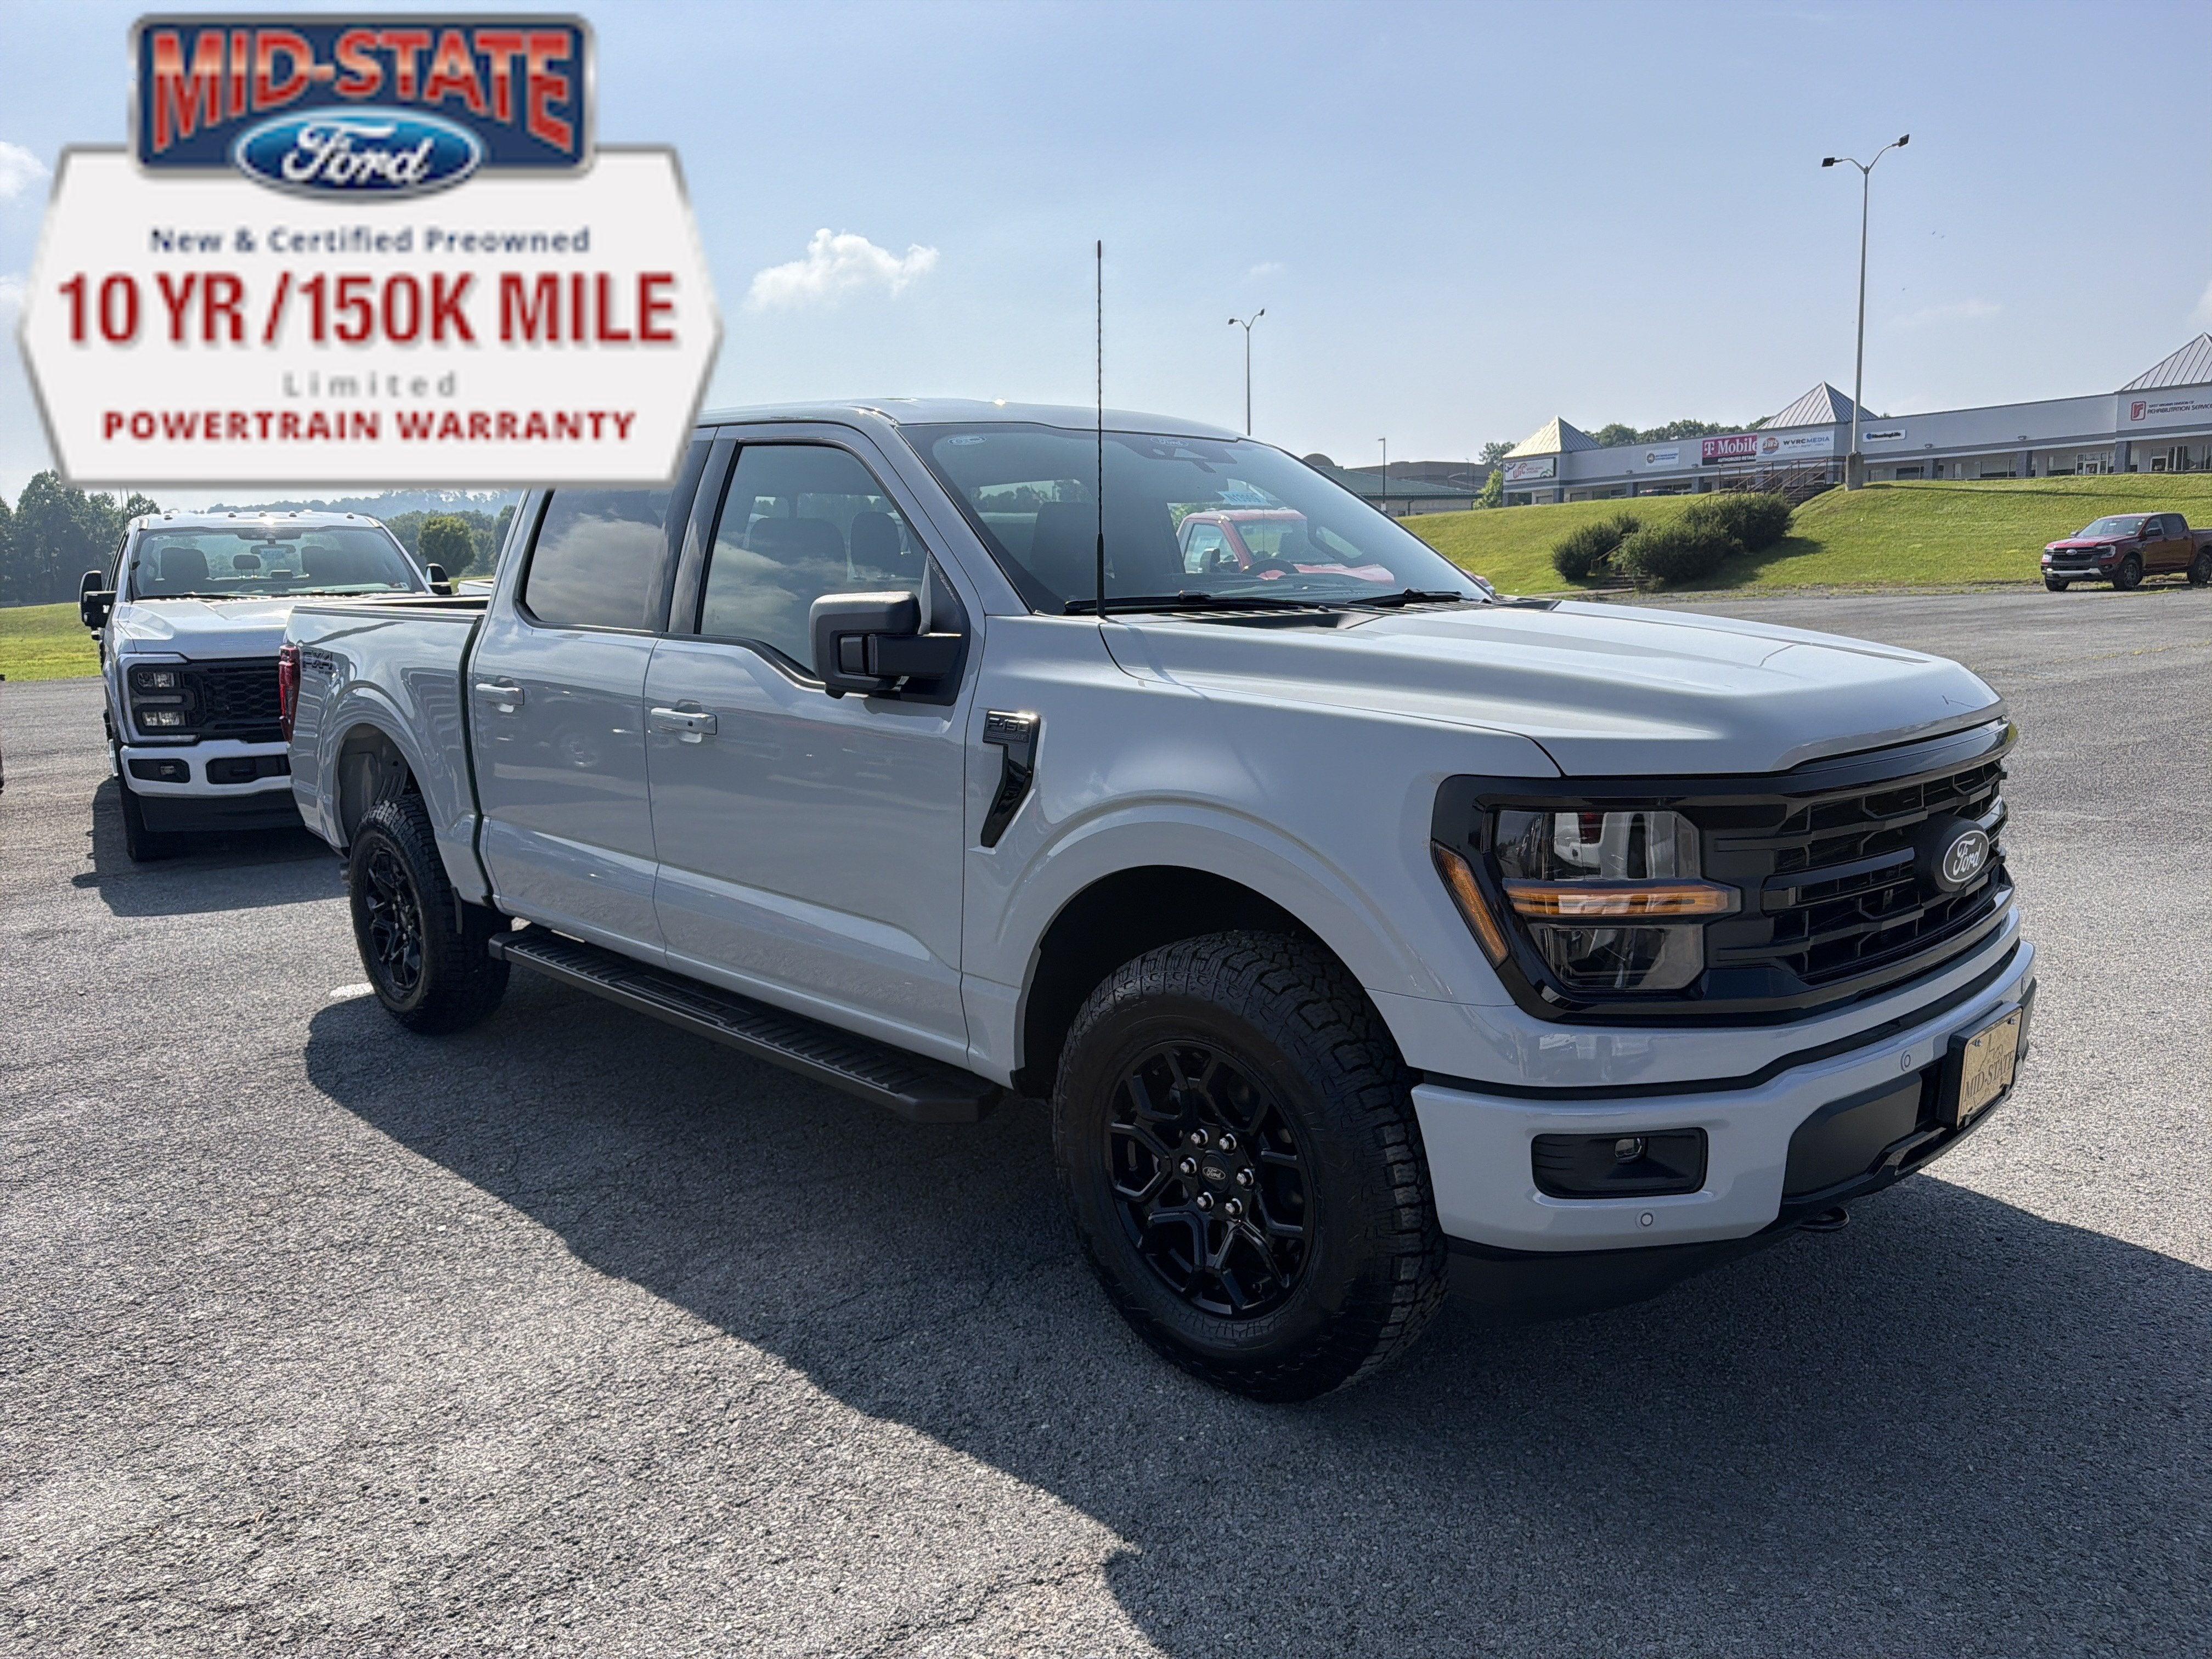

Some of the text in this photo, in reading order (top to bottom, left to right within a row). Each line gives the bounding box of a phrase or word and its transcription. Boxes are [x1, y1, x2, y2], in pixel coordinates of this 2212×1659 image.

[1953, 837, 1982, 876] Ford
[1963, 1049, 2015, 1102] MID-STATE
[1206, 1168, 1221, 1178] Ford
